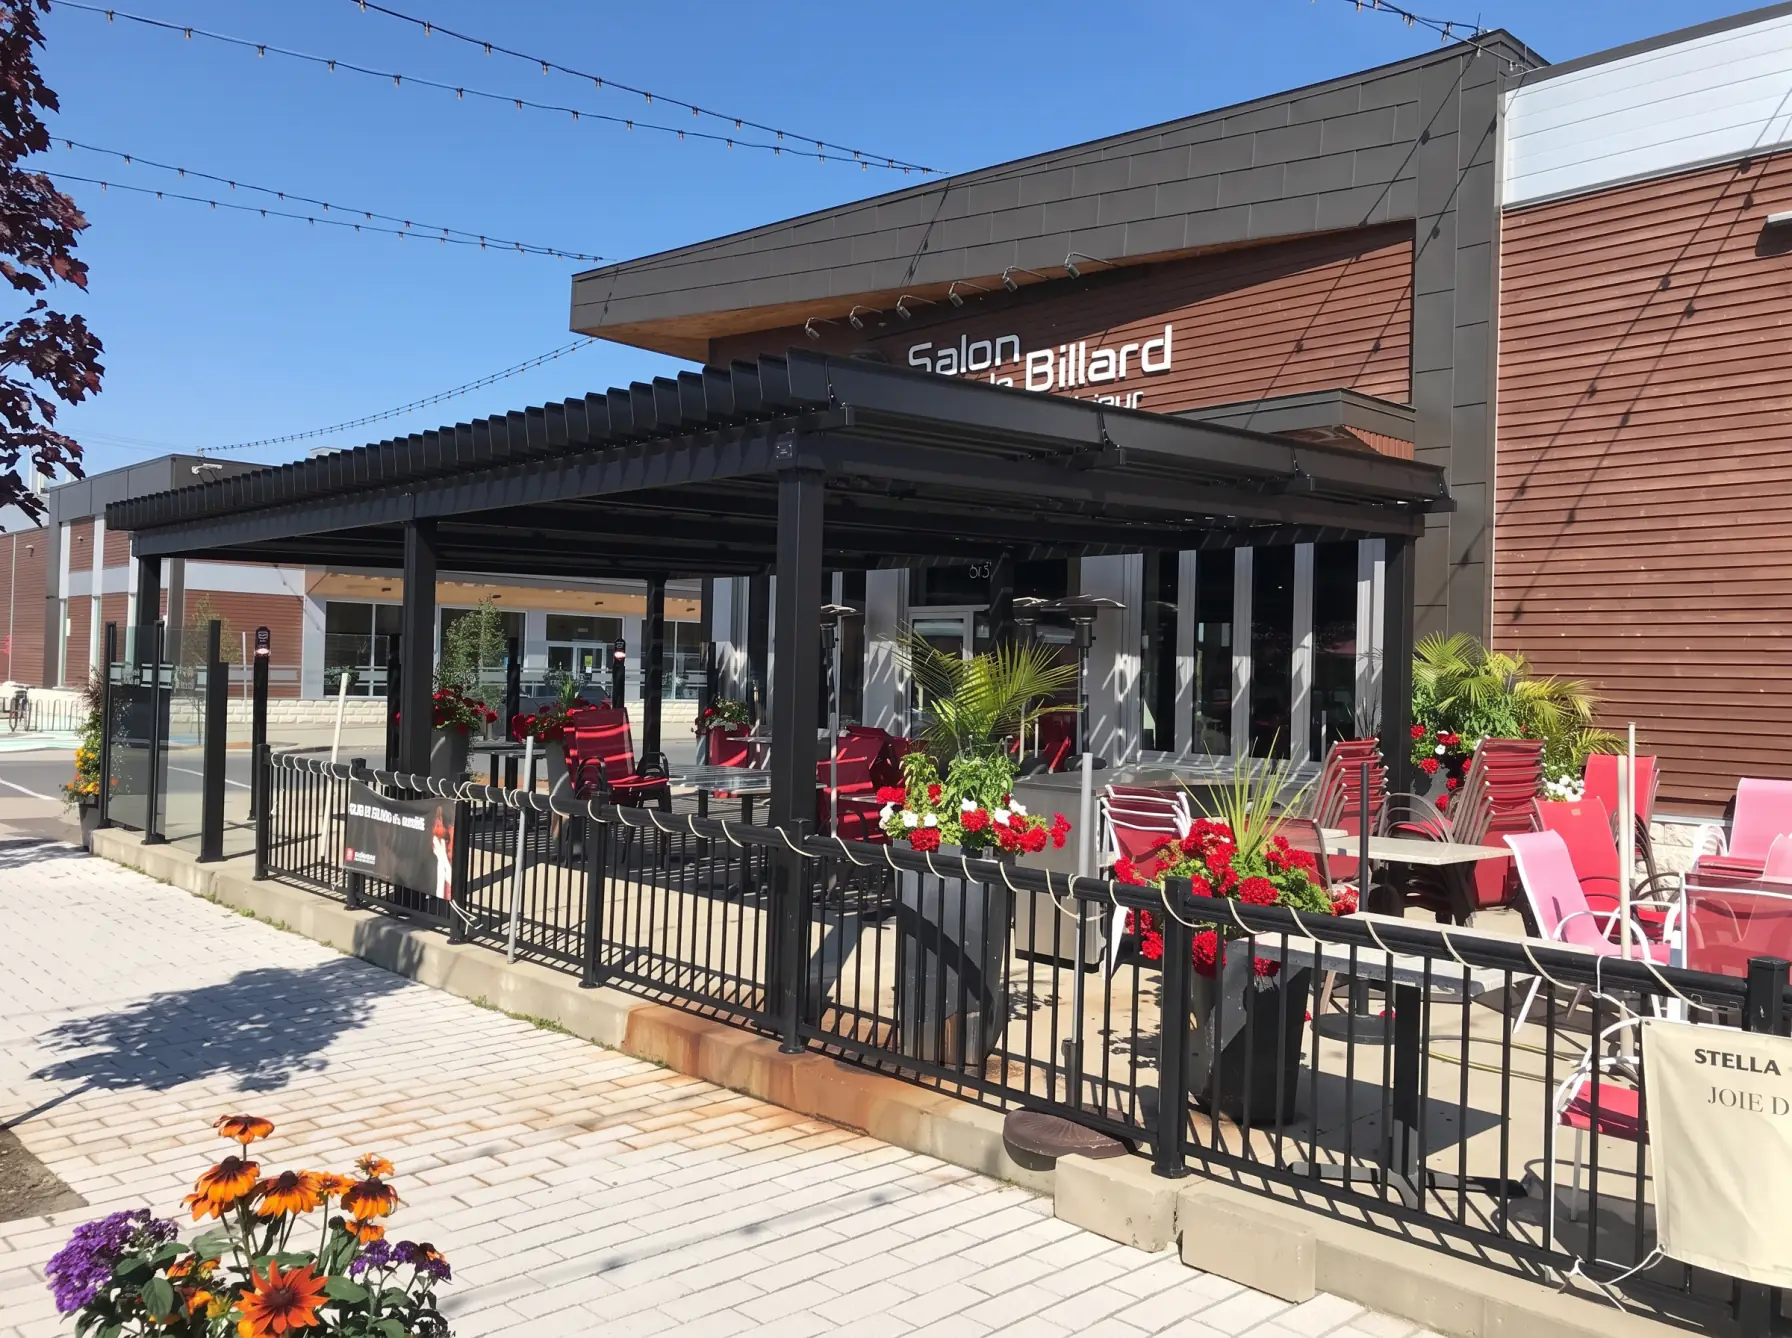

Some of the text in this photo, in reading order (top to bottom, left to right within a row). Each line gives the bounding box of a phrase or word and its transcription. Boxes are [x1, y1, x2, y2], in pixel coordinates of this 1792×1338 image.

[908, 333, 1020, 376] Salon
[1025, 324, 1172, 391] Billard
[1694, 1048, 1781, 1076] STELLA
[1707, 1086, 1764, 1113] JOIE
